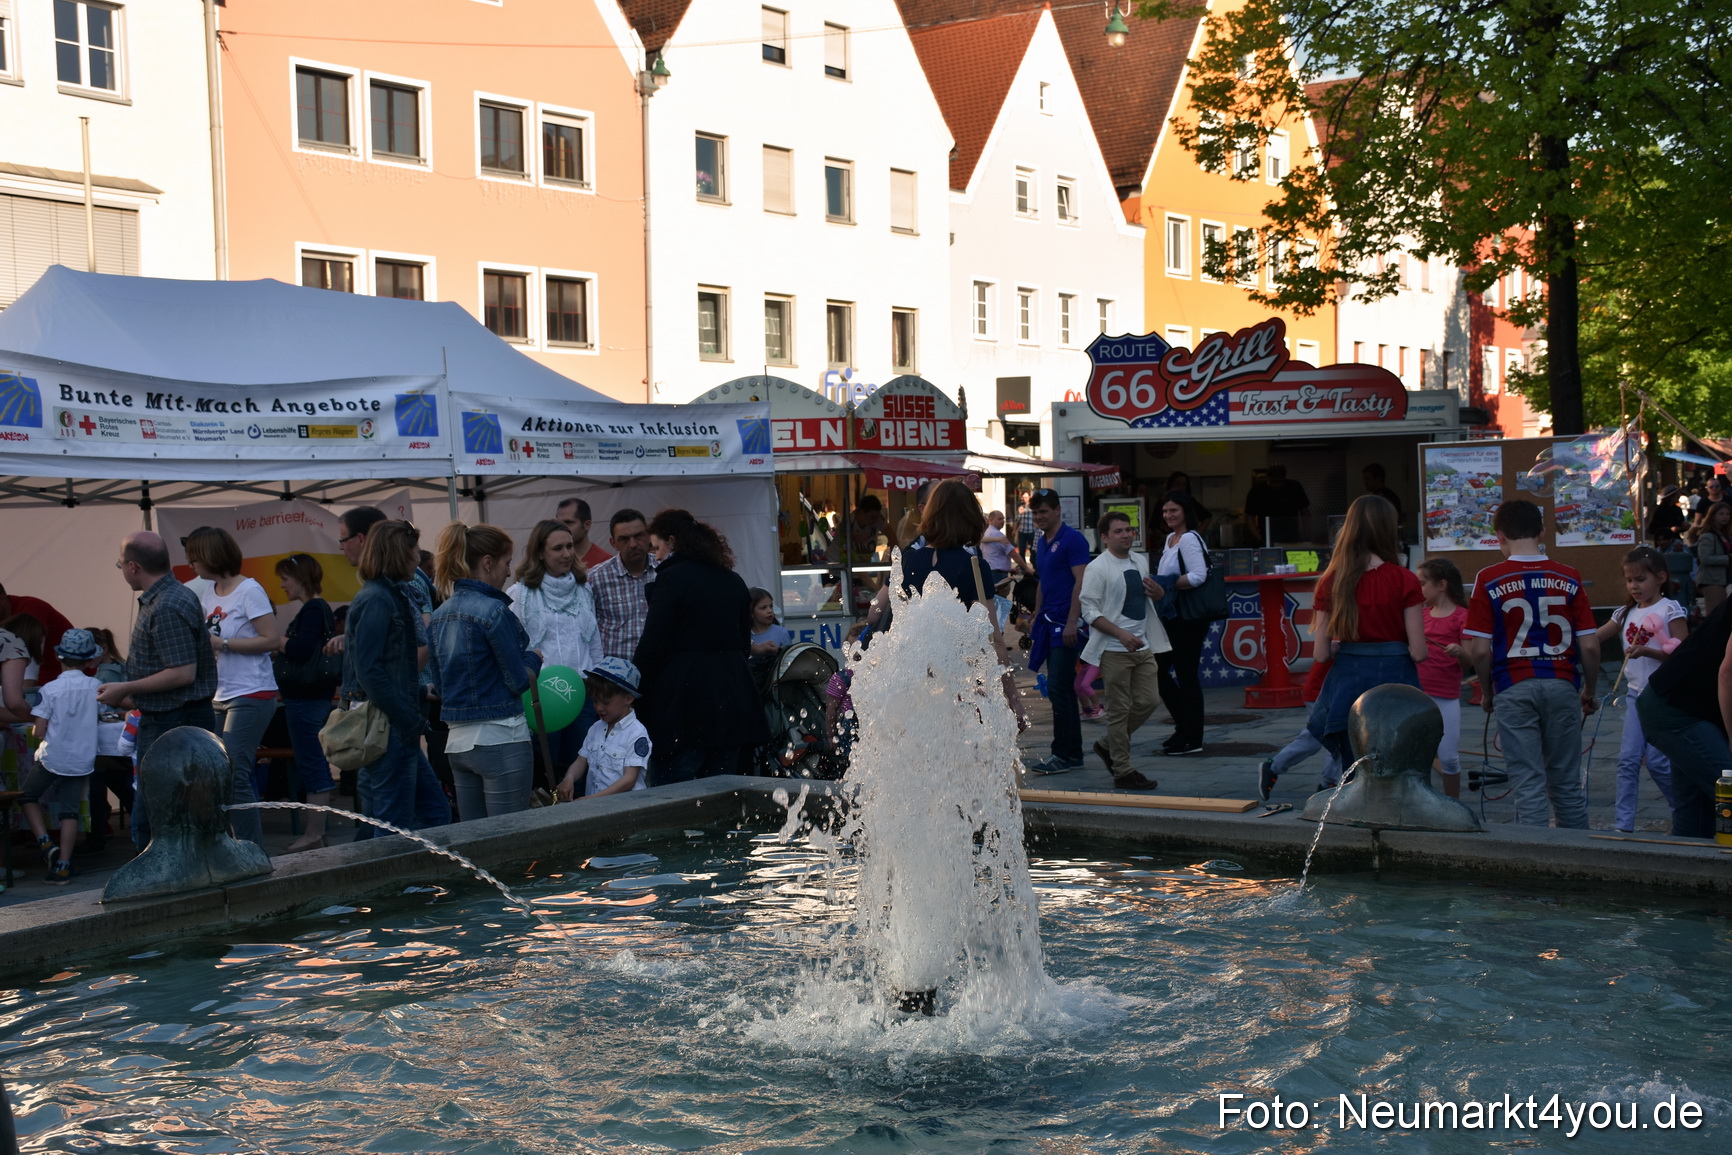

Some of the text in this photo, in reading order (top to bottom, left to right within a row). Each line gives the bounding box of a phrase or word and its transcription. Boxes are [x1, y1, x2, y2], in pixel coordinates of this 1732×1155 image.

[1100, 343, 1156, 358] ROUTE
[1166, 325, 1276, 401] Grill
[59, 384, 134, 408] Bunte
[271, 397, 381, 415] Angebote
[1101, 369, 1156, 410] 66
[1239, 384, 1394, 418] Fast & Tasty
[98, 416, 137, 425] Bayerisches
[521, 417, 719, 436] Aktionen zur Inklusion
[880, 420, 951, 447] BIENE
[235, 518, 257, 531] Wie
[1488, 578, 1578, 600] BAYERN MÜNCHEN
[1232, 601, 1262, 614] ROU
[1501, 596, 1572, 658] 25
[543, 676, 576, 701] AOK
